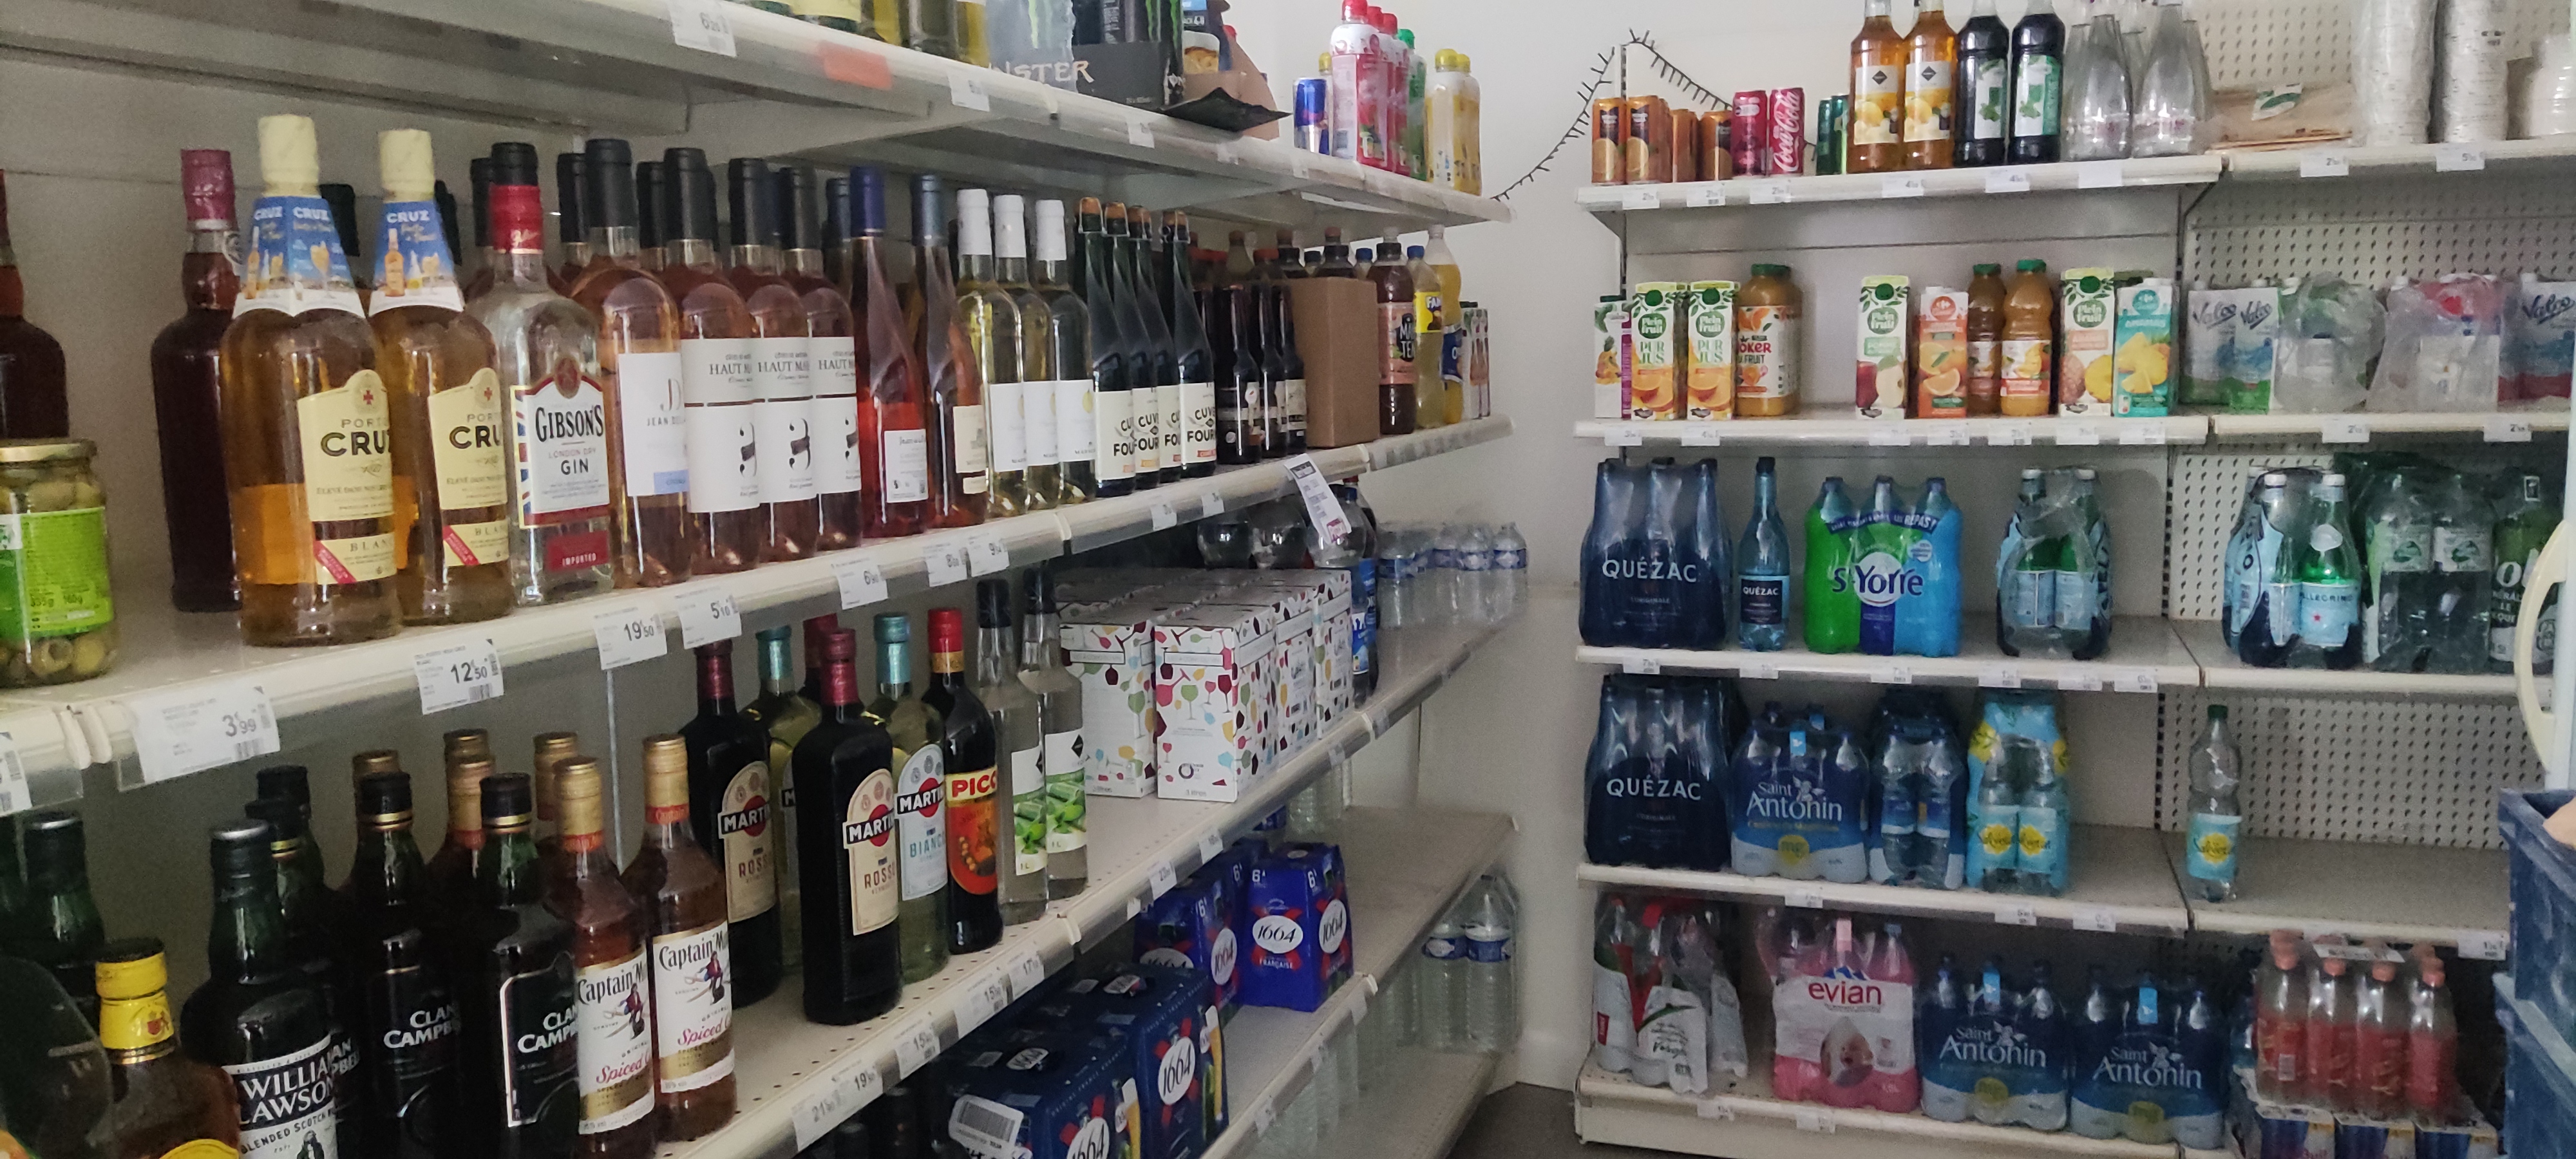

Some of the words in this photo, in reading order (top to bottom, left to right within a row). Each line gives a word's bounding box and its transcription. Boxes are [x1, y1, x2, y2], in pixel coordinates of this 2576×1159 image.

[254, 206, 283, 219] CRUZ
[293, 206, 330, 220] CRUZ
[386, 210, 430, 222] CRUZ
[1426, 297, 1442, 309] FAN
[1399, 323, 1414, 341] MA
[1402, 340, 1414, 359] TE
[1640, 341, 1665, 353] PUR
[1698, 340, 1723, 352] PUR
[1740, 342, 1772, 353] OKER
[818, 359, 847, 371] HAUT
[1639, 352, 1665, 364] JUS
[1698, 351, 1723, 364] JUS
[710, 362, 741, 375] HAUT
[758, 361, 791, 373] HAUT
[467, 413, 499, 423] POR
[535, 404, 605, 442] GIBSON'S
[647, 417, 668, 426] JEAN
[321, 430, 390, 456] CRU
[450, 426, 500, 449] CRU
[560, 458, 589, 475] GIN
[475, 525, 506, 537] BLA
[349, 539, 390, 553] BLAN
[562, 552, 597, 567] IMPORTED
[1602, 556, 1697, 583] QUÉZAC
[1743, 586, 1779, 596] QUÉZAC
[1606, 775, 1701, 801] QUÉZAC
[1757, 780, 1792, 797] Saint
[899, 787, 943, 813] MARTI
[1746, 791, 1843, 822] Antonin
[724, 805, 770, 833] MARTI
[849, 815, 895, 843] MARTI
[738, 857, 770, 878] ROSS
[1257, 924, 1297, 944] 1664
[1323, 910, 1344, 944] 1664
[658, 935, 714, 972] Captain
[577, 968, 634, 1006] Captain
[1808, 979, 1883, 1006] evian
[677, 1019, 722, 1046] Spiced
[1955, 1026, 1992, 1042] Saint
[1938, 1035, 2047, 1068] Antonin
[2110, 1046, 2147, 1062] Saint
[596, 1056, 643, 1084] Spiced
[1162, 1046, 1193, 1098] 1664
[2092, 1055, 2202, 1089] Antonin
[241, 1127, 291, 1155] BLENDED
